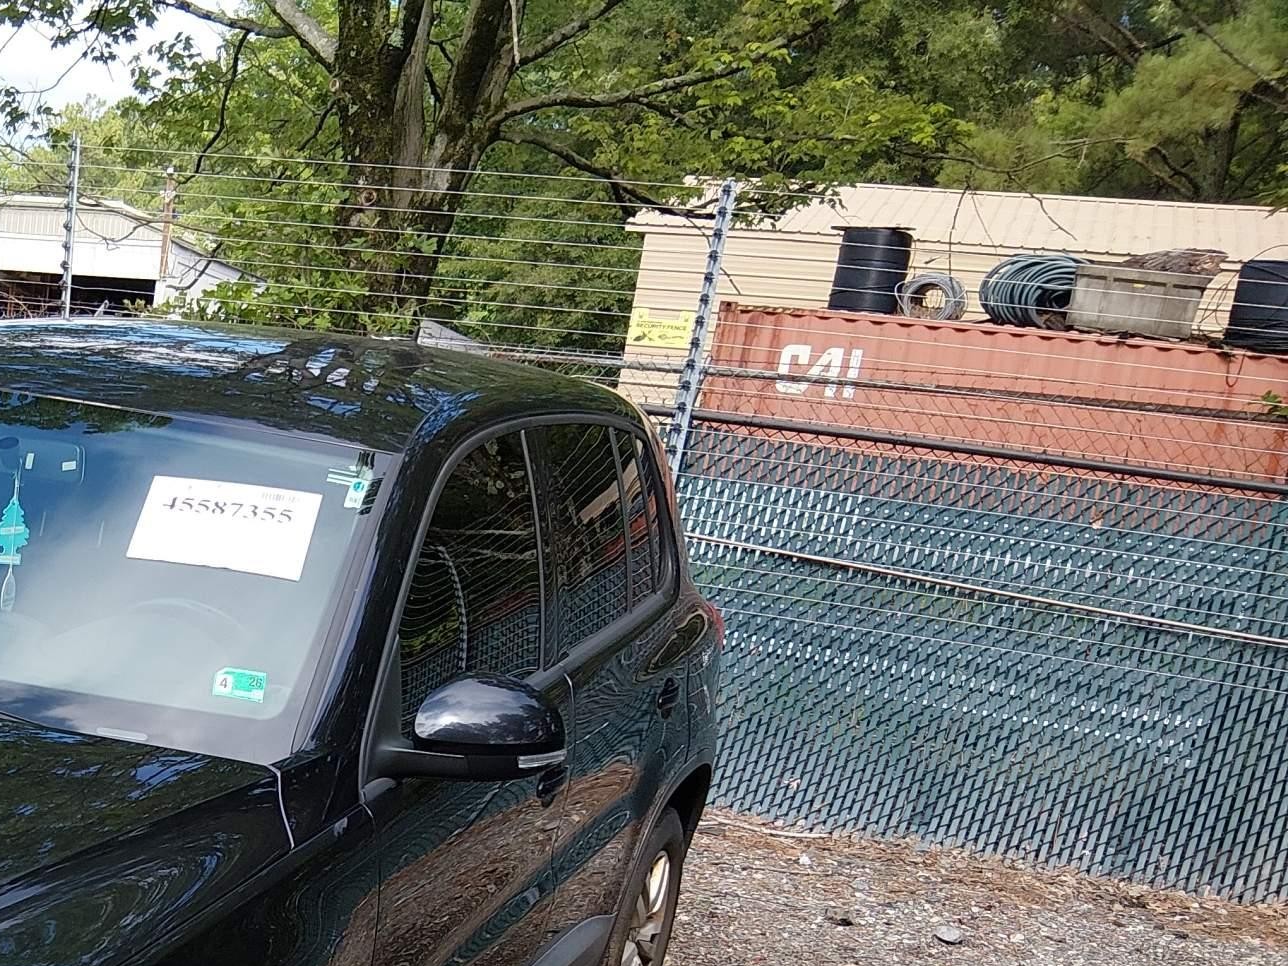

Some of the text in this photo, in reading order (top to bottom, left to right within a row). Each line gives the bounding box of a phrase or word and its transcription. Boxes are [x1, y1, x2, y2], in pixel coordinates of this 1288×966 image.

[775, 344, 863, 399] CAI
[162, 497, 294, 523] 45587355
[219, 677, 228, 688] 4
